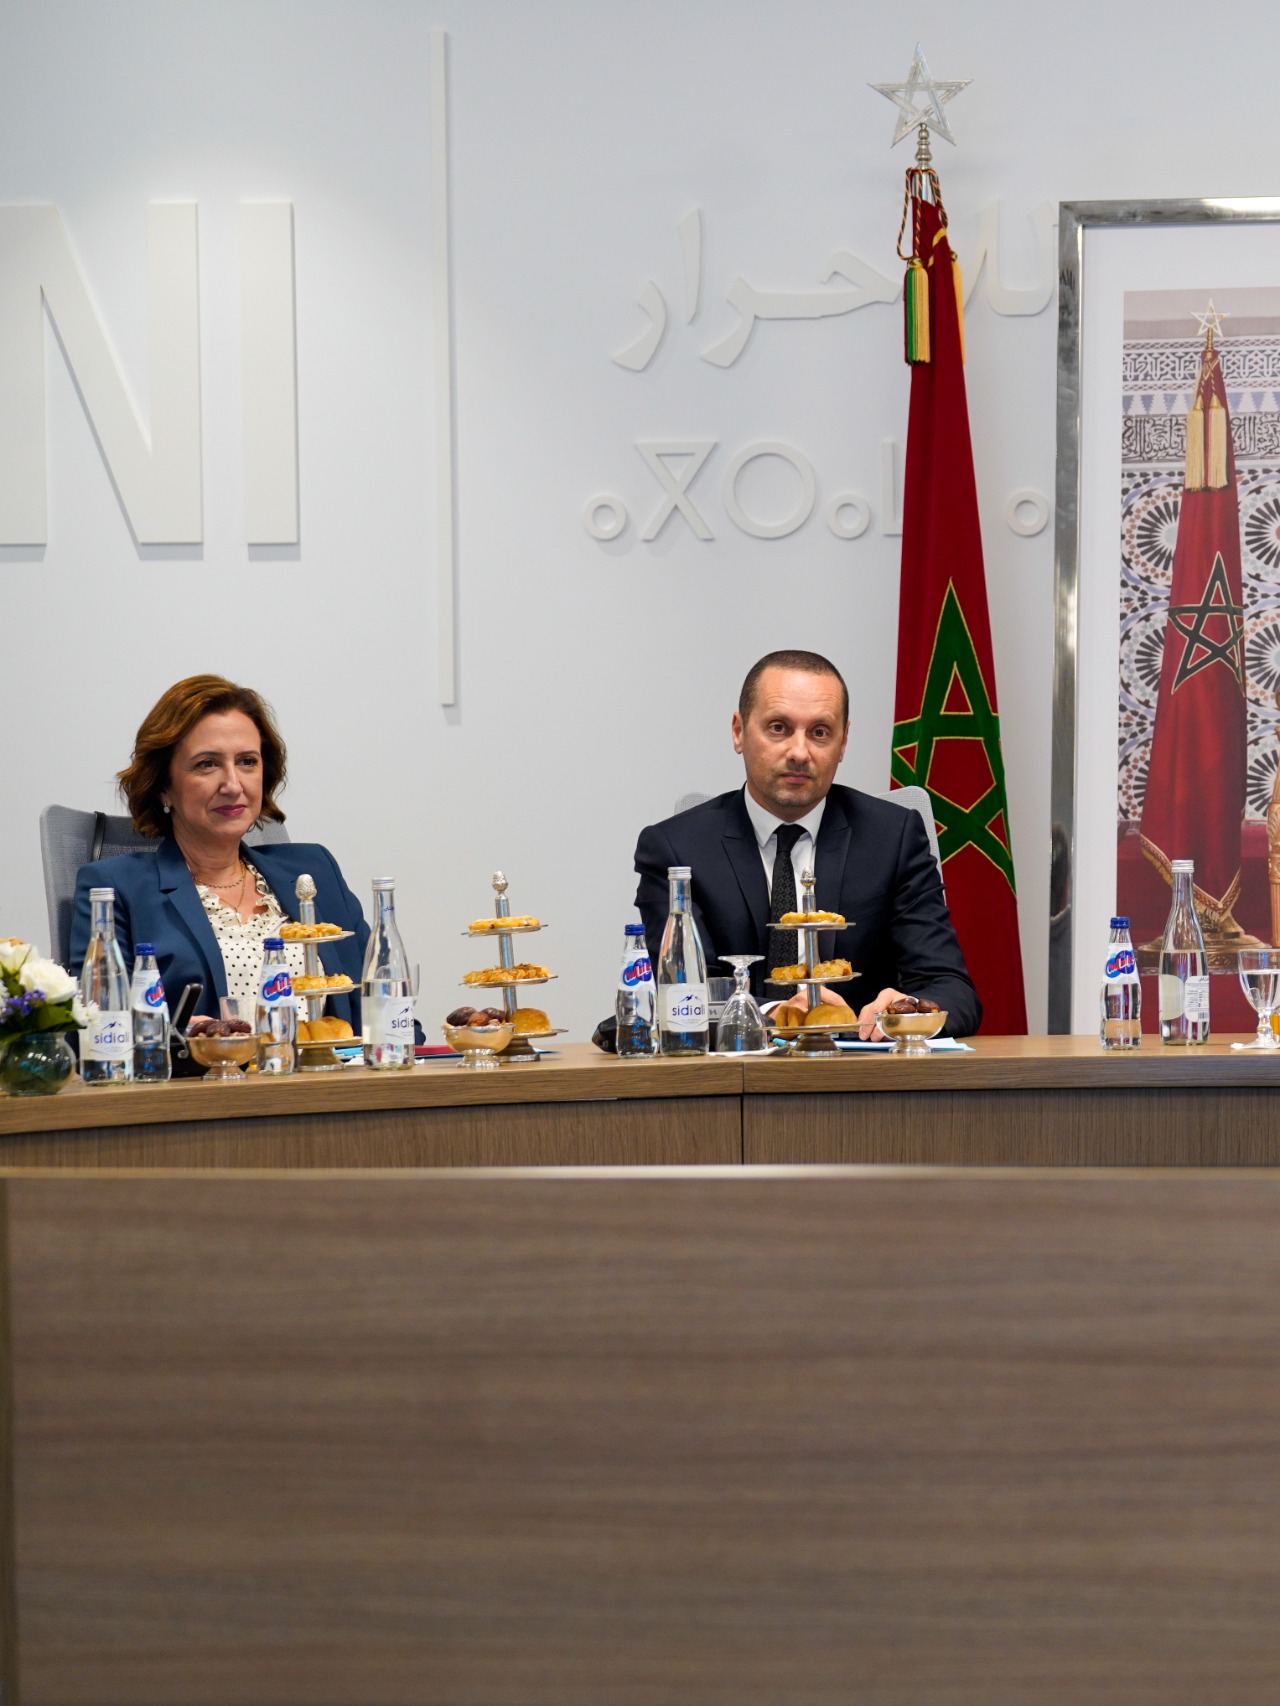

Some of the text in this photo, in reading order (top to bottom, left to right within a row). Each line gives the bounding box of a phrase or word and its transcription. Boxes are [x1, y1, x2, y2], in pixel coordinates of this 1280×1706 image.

[672, 1004, 693, 1016] sidi
[391, 1017, 411, 1029] sidi
[94, 1032, 116, 1044] sidi
